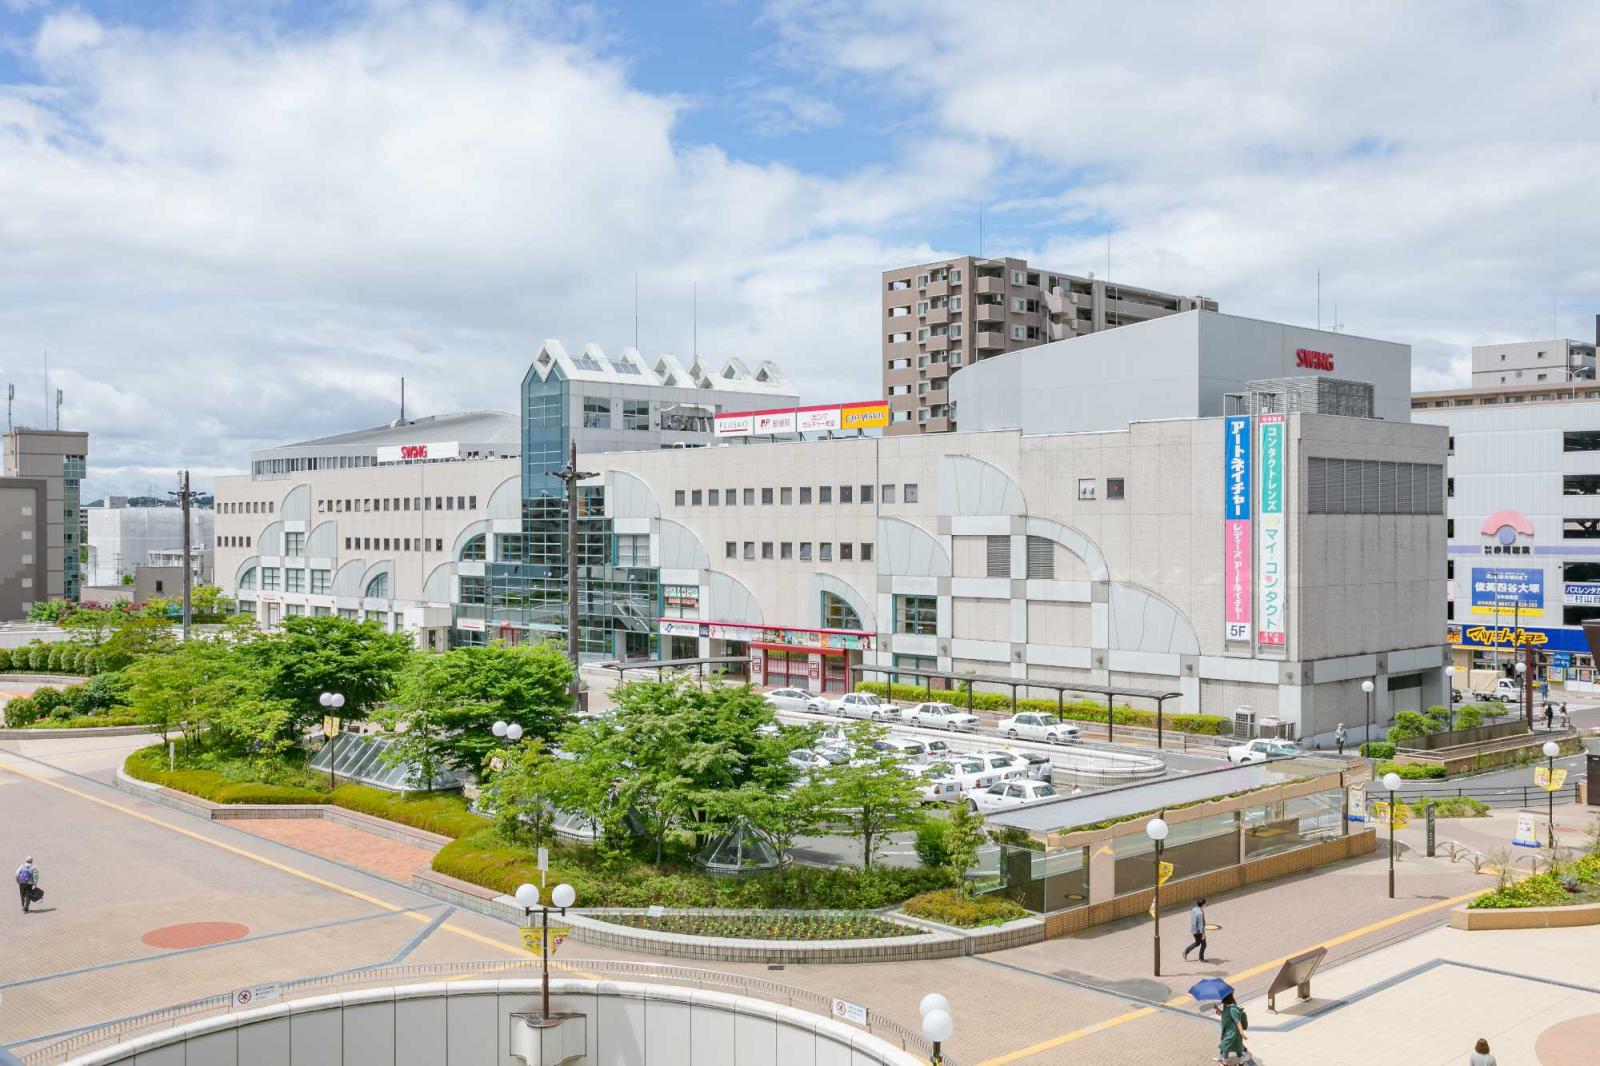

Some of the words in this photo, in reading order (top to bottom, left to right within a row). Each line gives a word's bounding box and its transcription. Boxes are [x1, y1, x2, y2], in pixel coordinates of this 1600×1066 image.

[1296, 348, 1334, 371] SWING
[719, 419, 748, 429] FUJISAKI
[400, 444, 428, 459] SWING
[1230, 421, 1246, 516] アートネイチャー
[1267, 427, 1278, 511] コンタクトレンズ
[1232, 523, 1246, 620] レディースアートネイチャー
[1230, 625, 1246, 637] 5F
